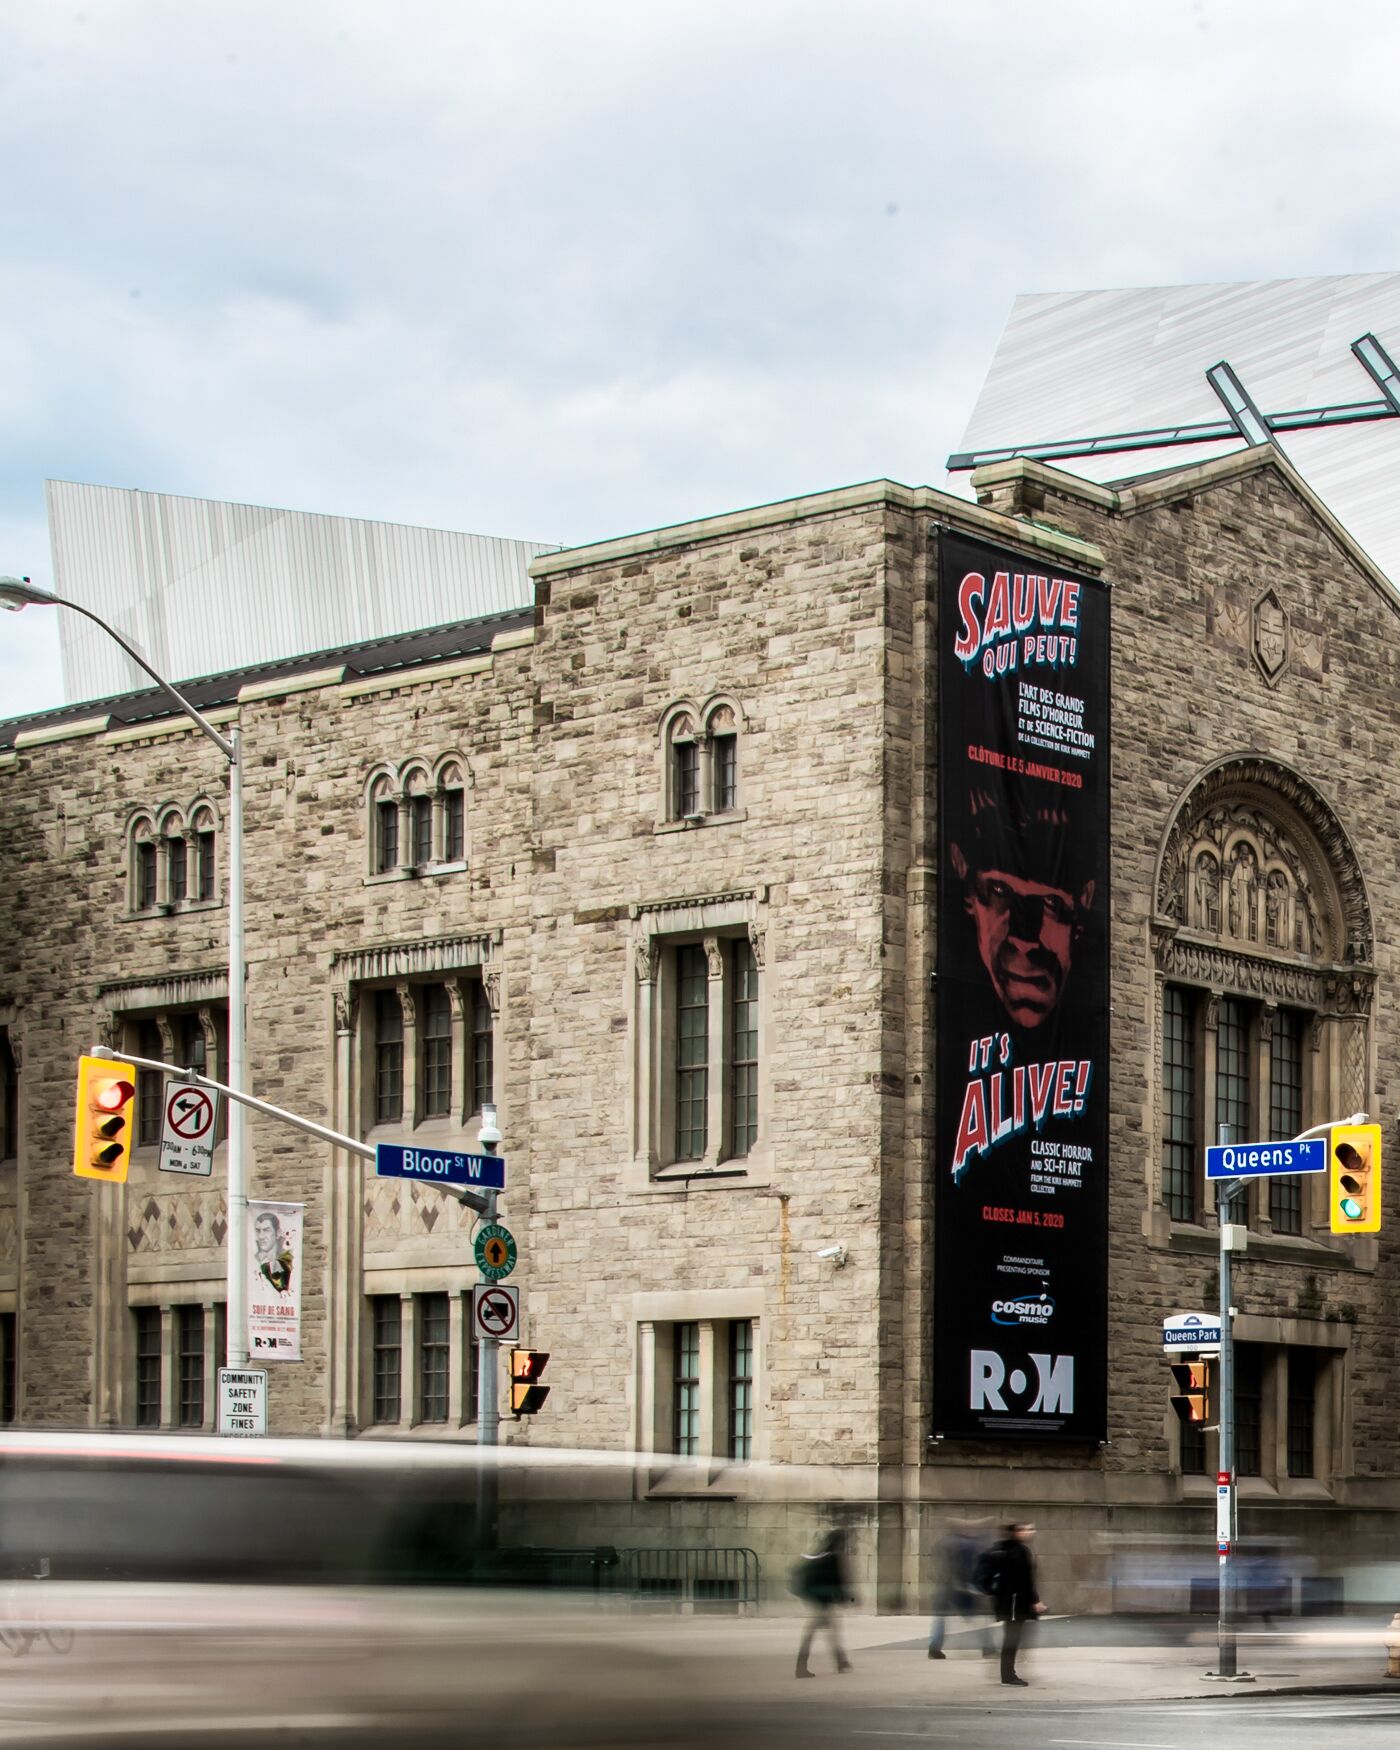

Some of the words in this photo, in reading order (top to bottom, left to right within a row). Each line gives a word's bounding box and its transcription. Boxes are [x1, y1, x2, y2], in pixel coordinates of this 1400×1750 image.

[954, 571, 1081, 661] SAUVE
[982, 640, 1017, 678] QUI
[1024, 635, 1077, 665] PEUT!
[1019, 681, 1038, 700] L'ART
[1040, 688, 1053, 705] DES
[1055, 693, 1084, 713] GRANDS
[1018, 698, 1041, 718] FILMS
[1042, 705, 1083, 729] D'HORREUR
[1018, 717, 1025, 729] ET
[1026, 720, 1034, 732] DE
[1035, 720, 1094, 748] SCIENCE-FICTION
[1018, 732, 1024, 741] DE
[1025, 734, 1030, 743] LA
[1055, 742, 1060, 751] DE
[968, 744, 1005, 769] CLÔTURE
[1007, 756, 1017, 772] LE
[1019, 760, 1024, 774] 5
[1025, 761, 1060, 783] JANVIER
[1061, 770, 1082, 788] 2020
[969, 1032, 1009, 1072] IT'S
[951, 1061, 1091, 1177] ALIVE!
[1031, 1140, 1060, 1157] CLASSIC
[1062, 1144, 1092, 1161] HORROR
[1222, 1148, 1293, 1171] Queens
[1299, 1144, 1311, 1154] Pk
[402, 1150, 452, 1175] Bloor
[454, 1156, 464, 1168] St
[467, 1157, 482, 1178] W
[1031, 1160, 1042, 1170] AND
[1044, 1159, 1066, 1174] SCI-FI
[1067, 1161, 1082, 1175] ART
[1031, 1174, 1043, 1182] FROM
[983, 1206, 1014, 1223] CLOSES
[1016, 1210, 1033, 1225] JAN
[1043, 1213, 1064, 1228] 2020
[479, 1226, 513, 1246] GARDINER
[476, 1253, 515, 1279] EXPRESSWAY
[1027, 1267, 1050, 1276] SPONSOR
[992, 1300, 1053, 1317] cosmo
[1019, 1315, 1048, 1324] music
[1165, 1331, 1197, 1342] Queens
[1198, 1330, 1218, 1341] Park
[222, 1374, 263, 1385] COMMUNITY
[228, 1388, 256, 1399] SAFETY
[233, 1402, 253, 1413] ZONE
[231, 1419, 254, 1429] FINES
